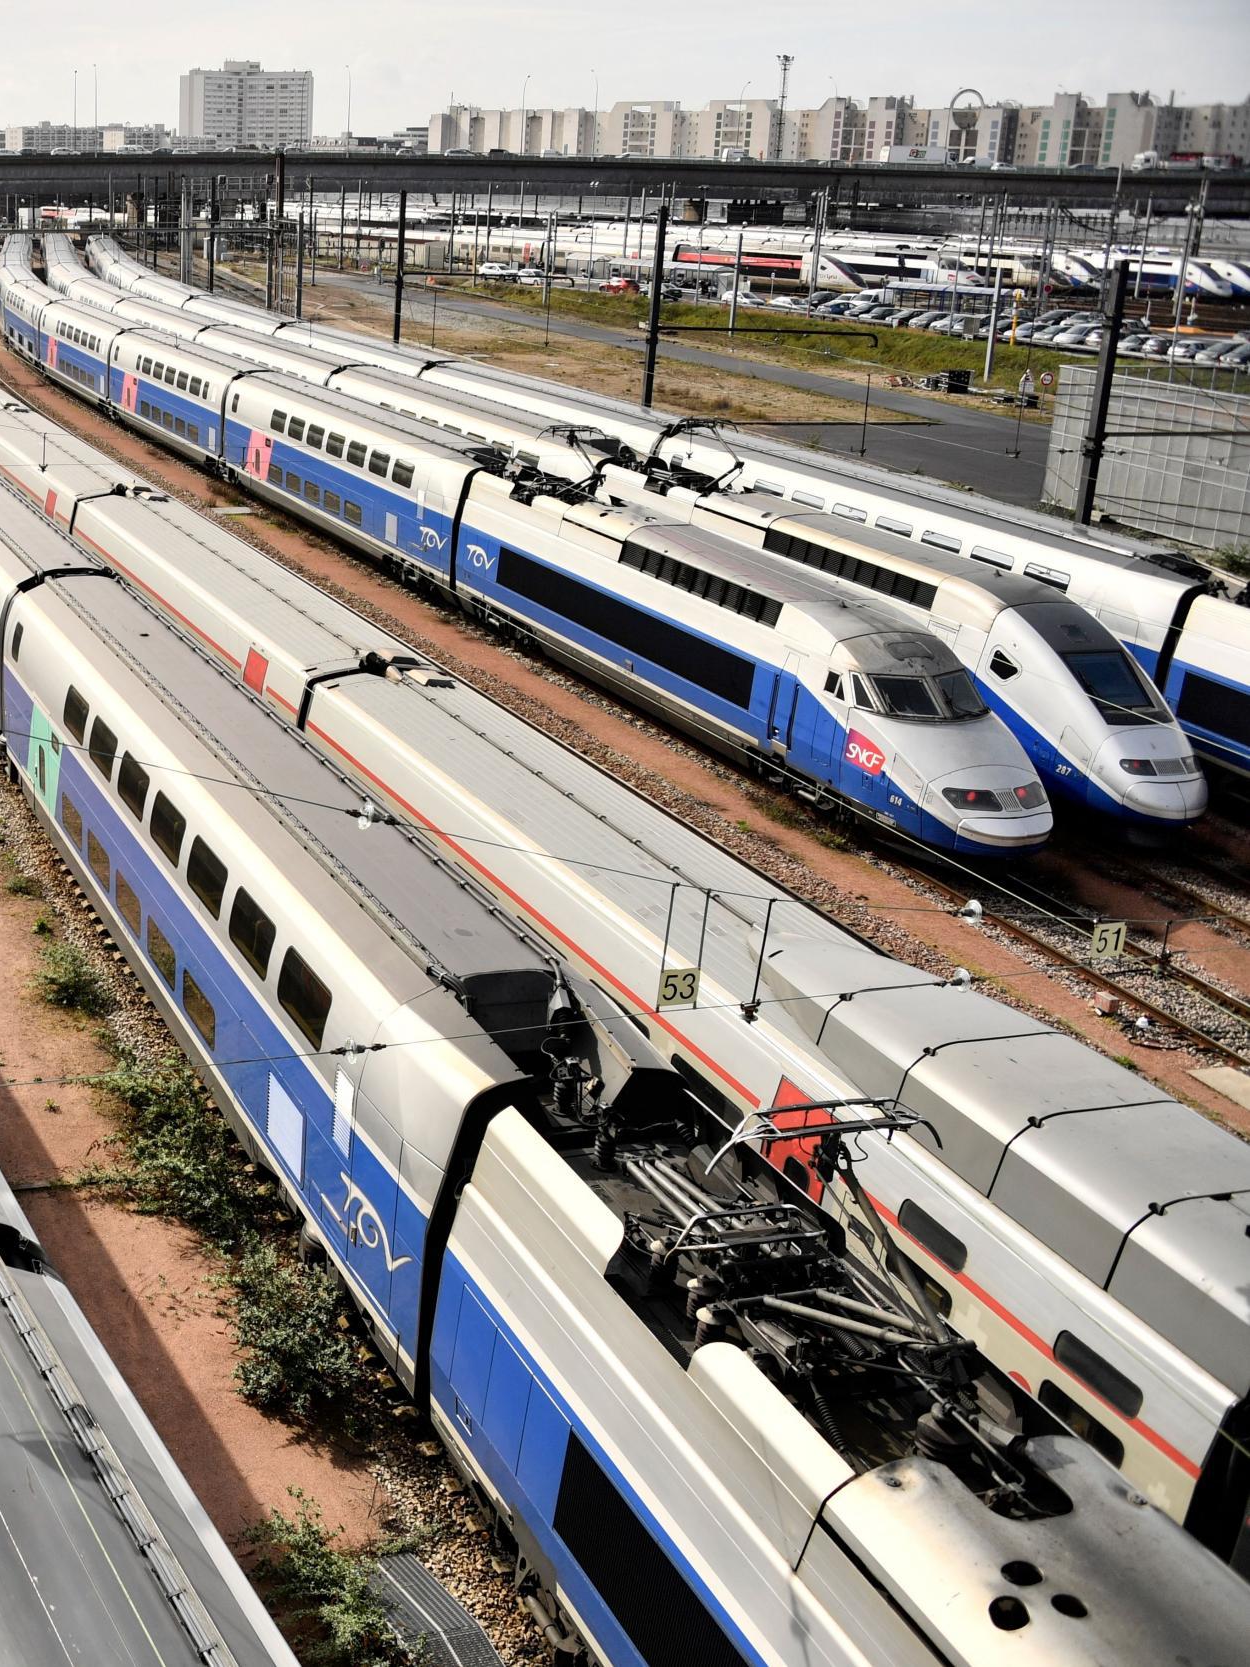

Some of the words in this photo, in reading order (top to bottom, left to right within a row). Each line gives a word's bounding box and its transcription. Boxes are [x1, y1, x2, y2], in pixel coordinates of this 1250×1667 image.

[419, 526, 448, 550] TGV
[466, 544, 496, 570] TGV
[846, 743, 883, 767] SNCF
[1055, 764, 1072, 776] 287
[889, 794, 903, 806] 614
[1096, 927, 1122, 953] 51
[662, 973, 696, 1001] 53
[340, 1171, 412, 1271] TGV
